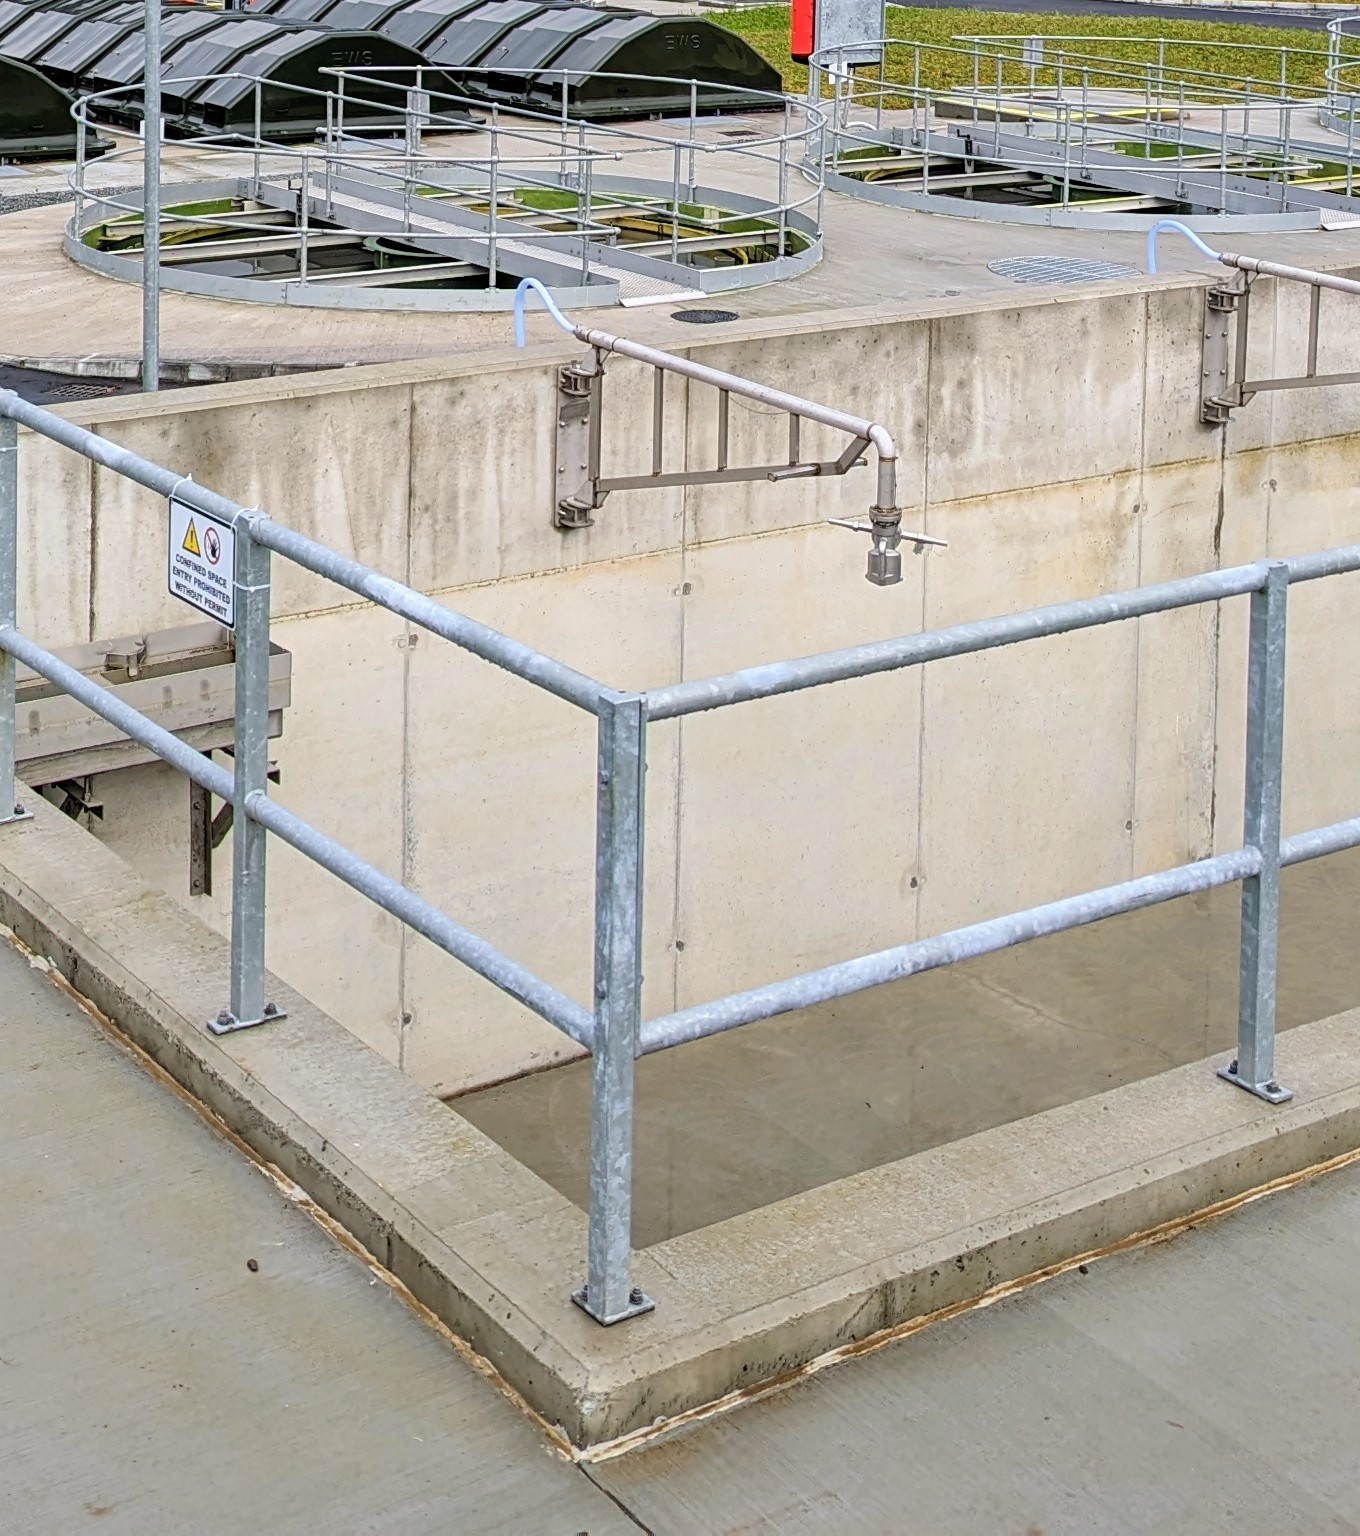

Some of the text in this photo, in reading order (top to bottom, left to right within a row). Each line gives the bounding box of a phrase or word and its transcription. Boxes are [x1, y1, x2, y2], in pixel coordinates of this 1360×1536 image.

[331, 50, 372, 67] EWS
[665, 34, 700, 50] EWS
[172, 565, 230, 604] ENTRY PROHIBITED
[176, 554, 227, 589] CONFINED SPACE
[175, 580, 227, 617] WITHOUT PERMIT
